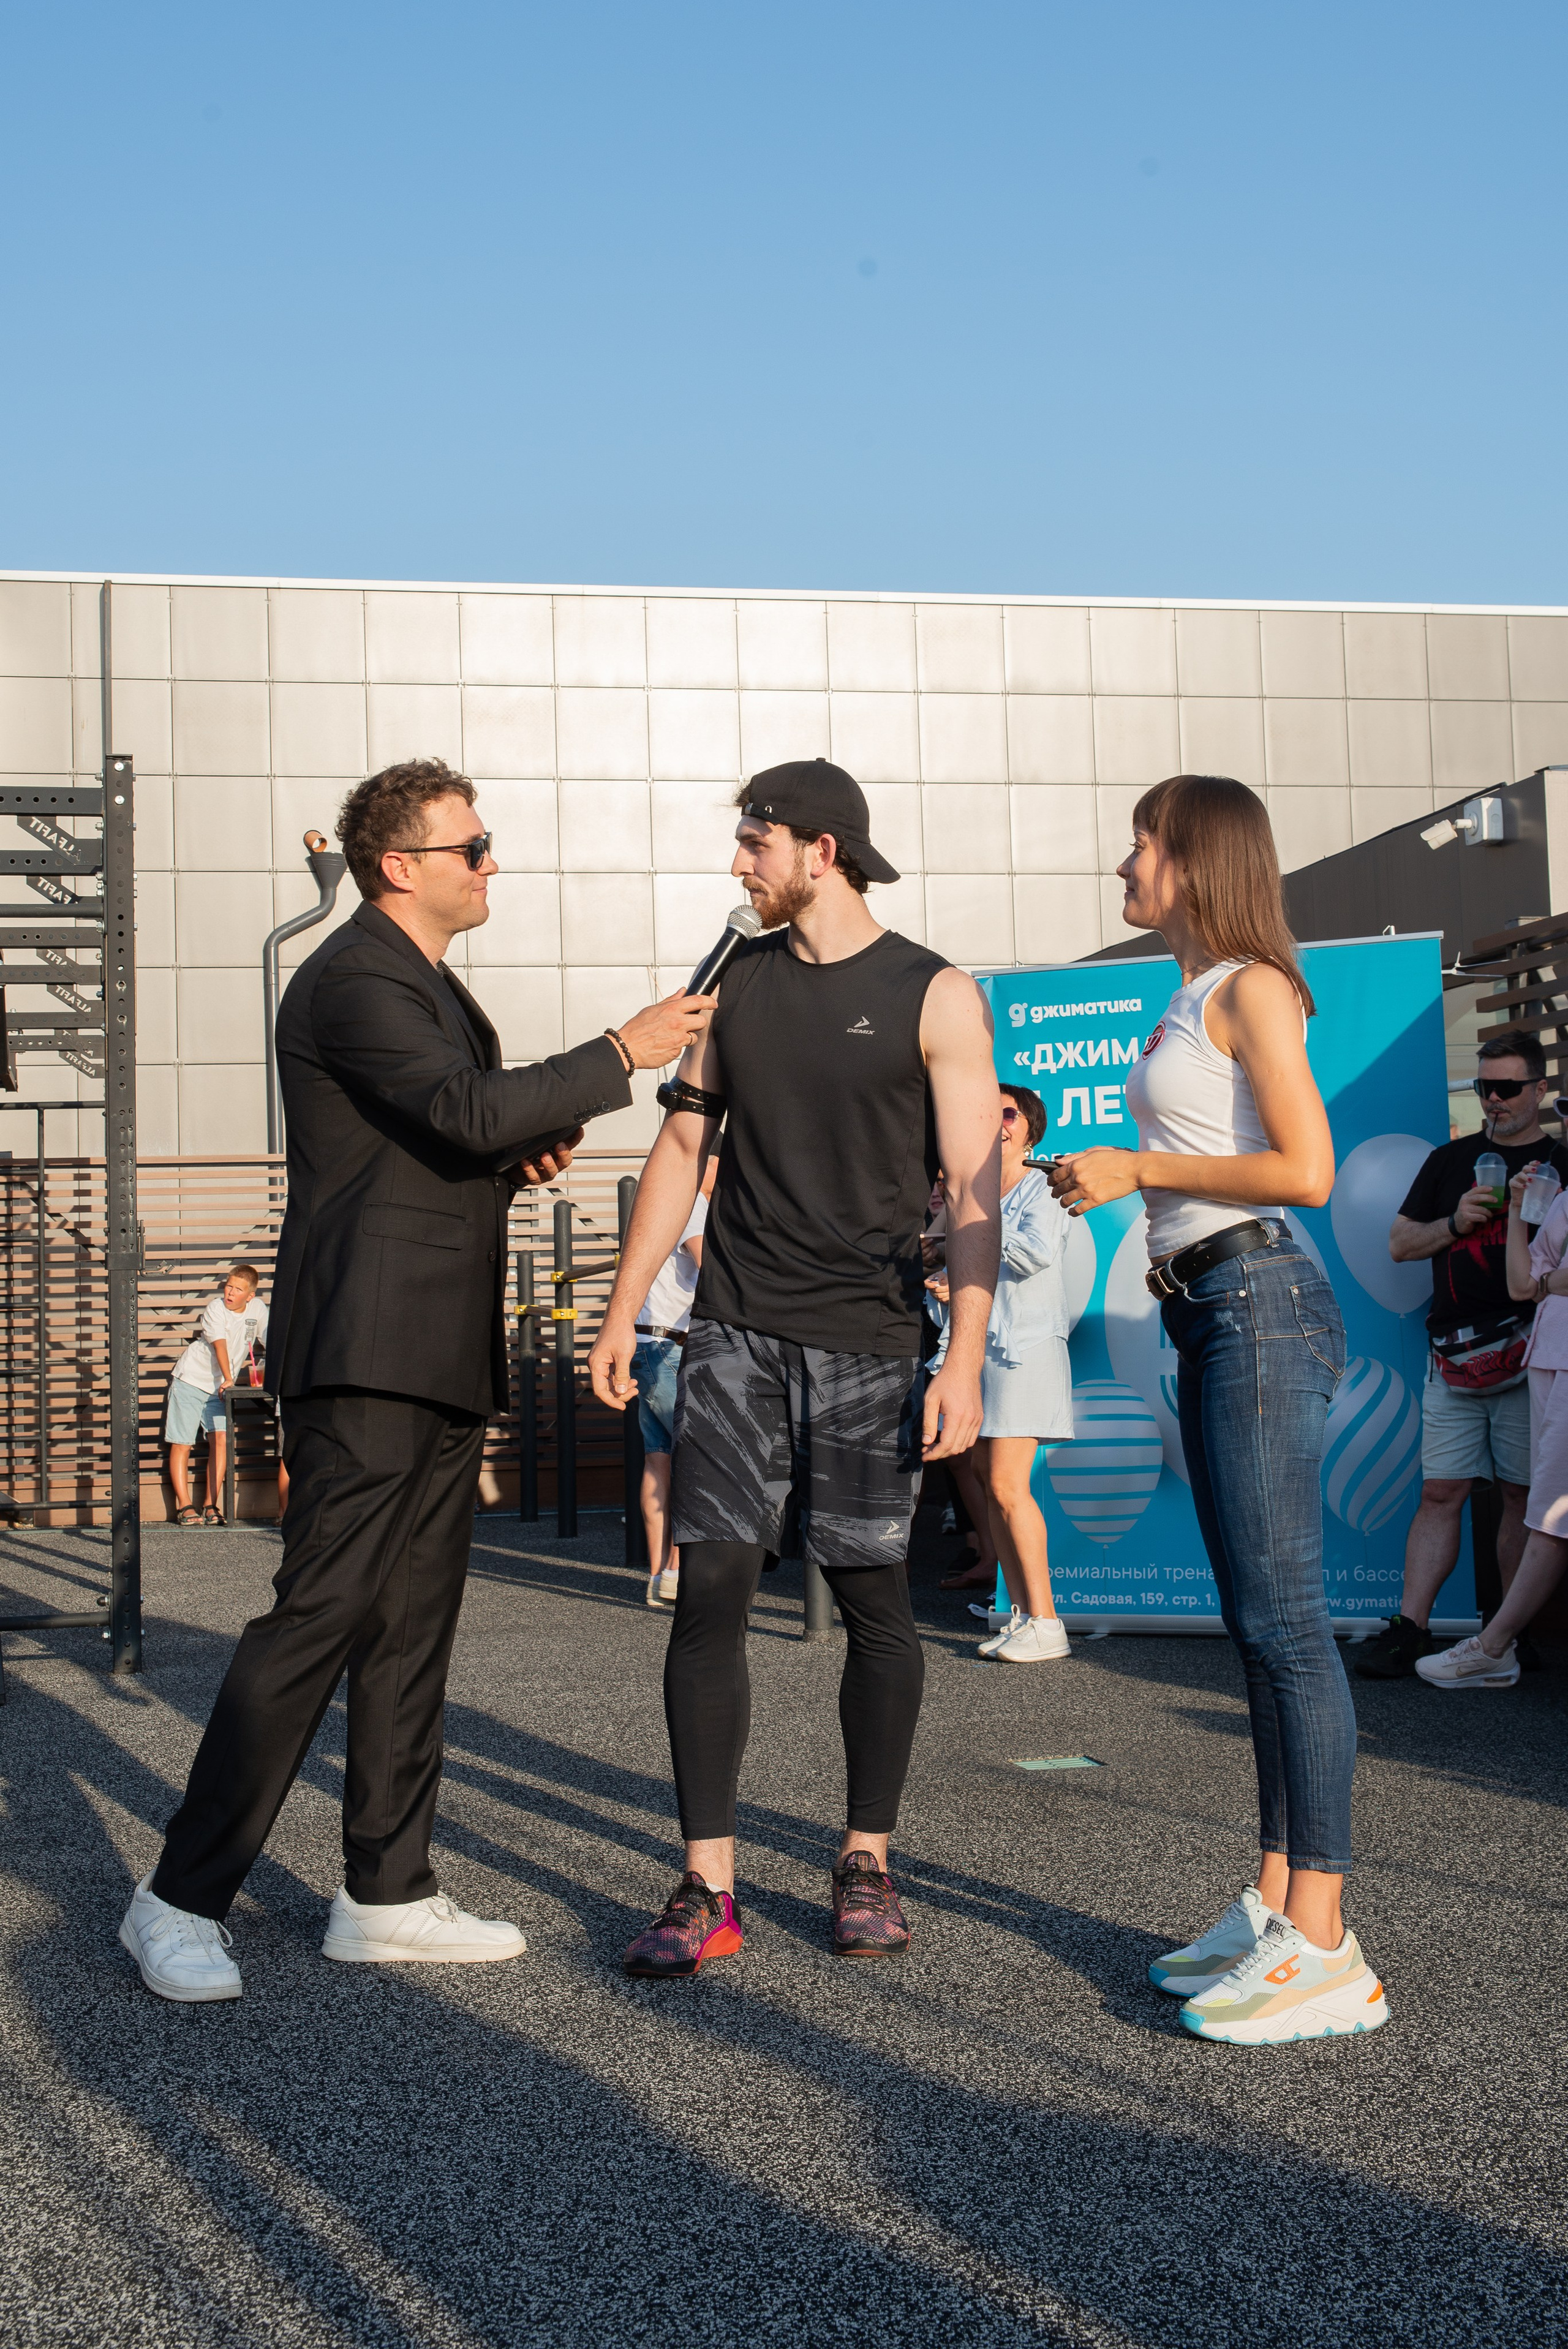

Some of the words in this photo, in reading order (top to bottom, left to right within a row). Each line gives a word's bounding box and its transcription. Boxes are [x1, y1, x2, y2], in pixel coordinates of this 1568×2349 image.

[1057, 1084, 1126, 1127] ЛЕ
[1336, 1569, 1347, 1581] и
[1071, 1591, 1136, 1606] Садовая,
[1140, 1593, 1168, 1606] 159,
[1172, 1594, 1201, 1608] стр.
[1205, 1593, 1215, 1607] 1,
[1265, 1918, 1285, 1937] DIESEL
